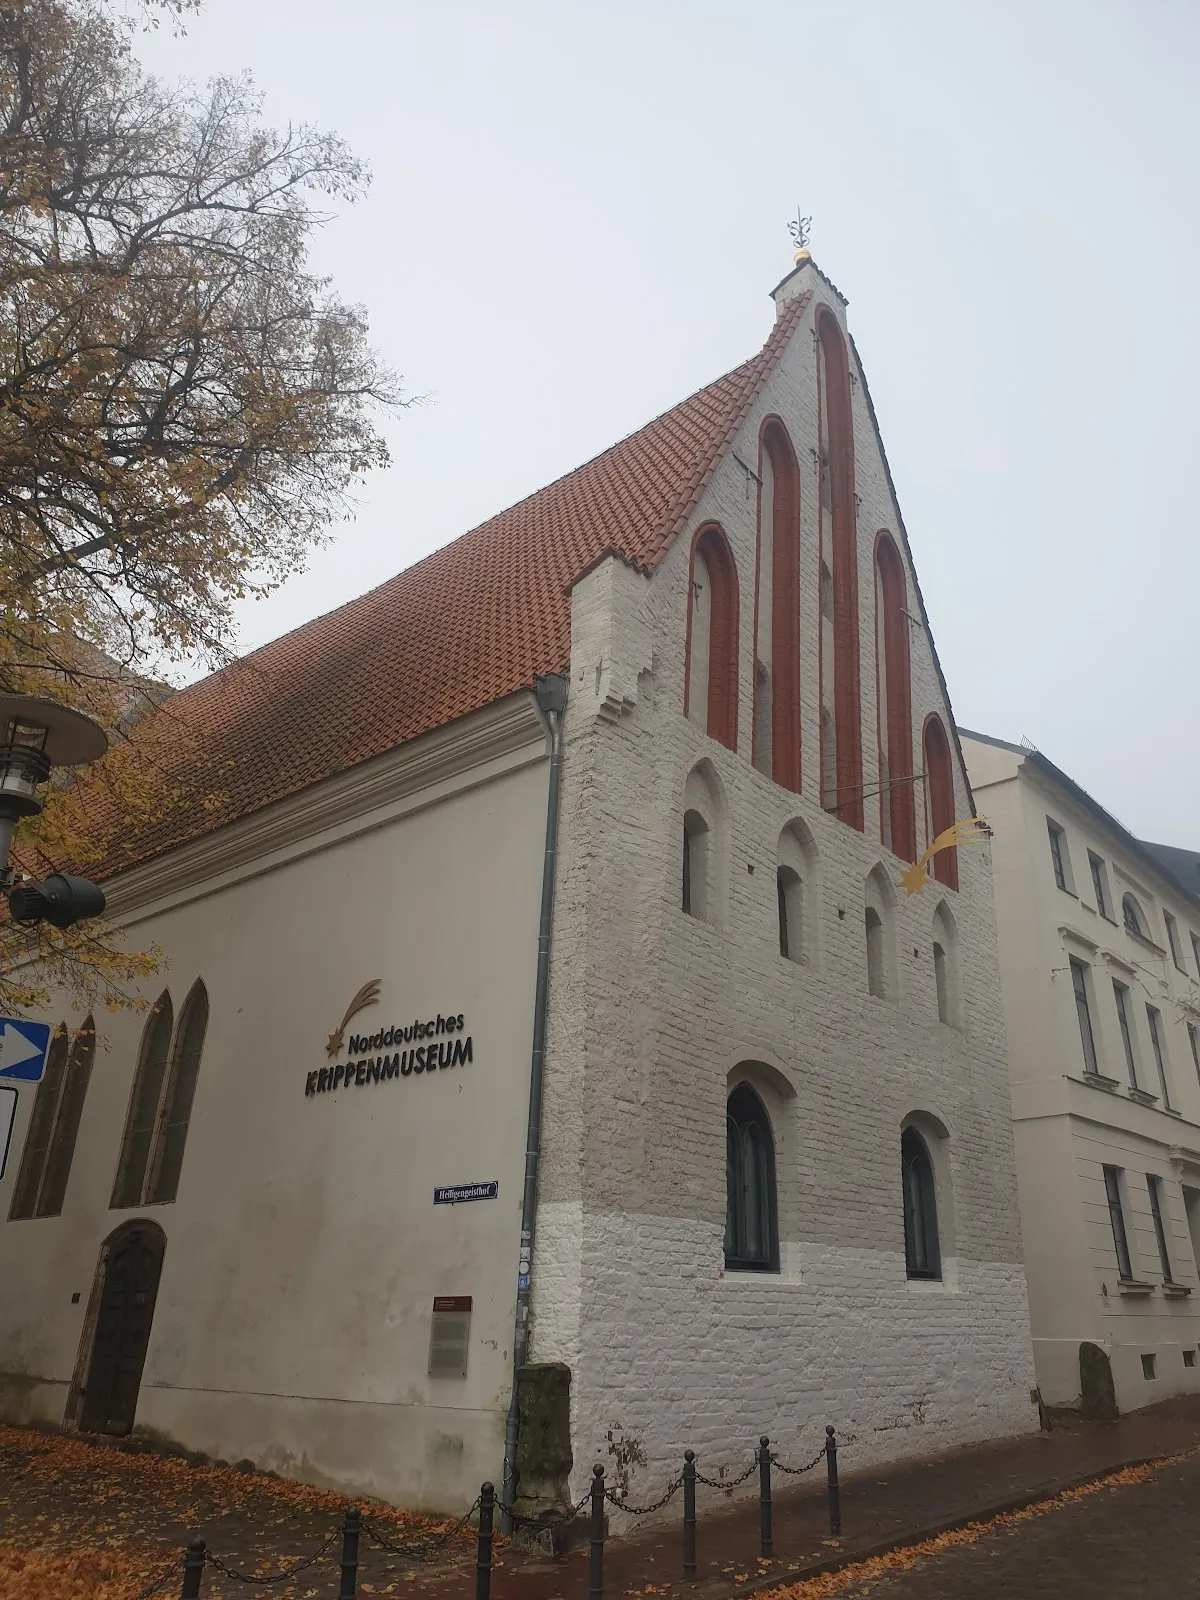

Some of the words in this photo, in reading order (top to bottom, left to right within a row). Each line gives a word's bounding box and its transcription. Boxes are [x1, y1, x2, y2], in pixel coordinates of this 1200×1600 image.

[348, 1014, 464, 1055] Norddeutsches
[304, 1036, 473, 1097] KRIPPENMUSEUM
[439, 1185, 491, 1200] Heiligengeisthof
